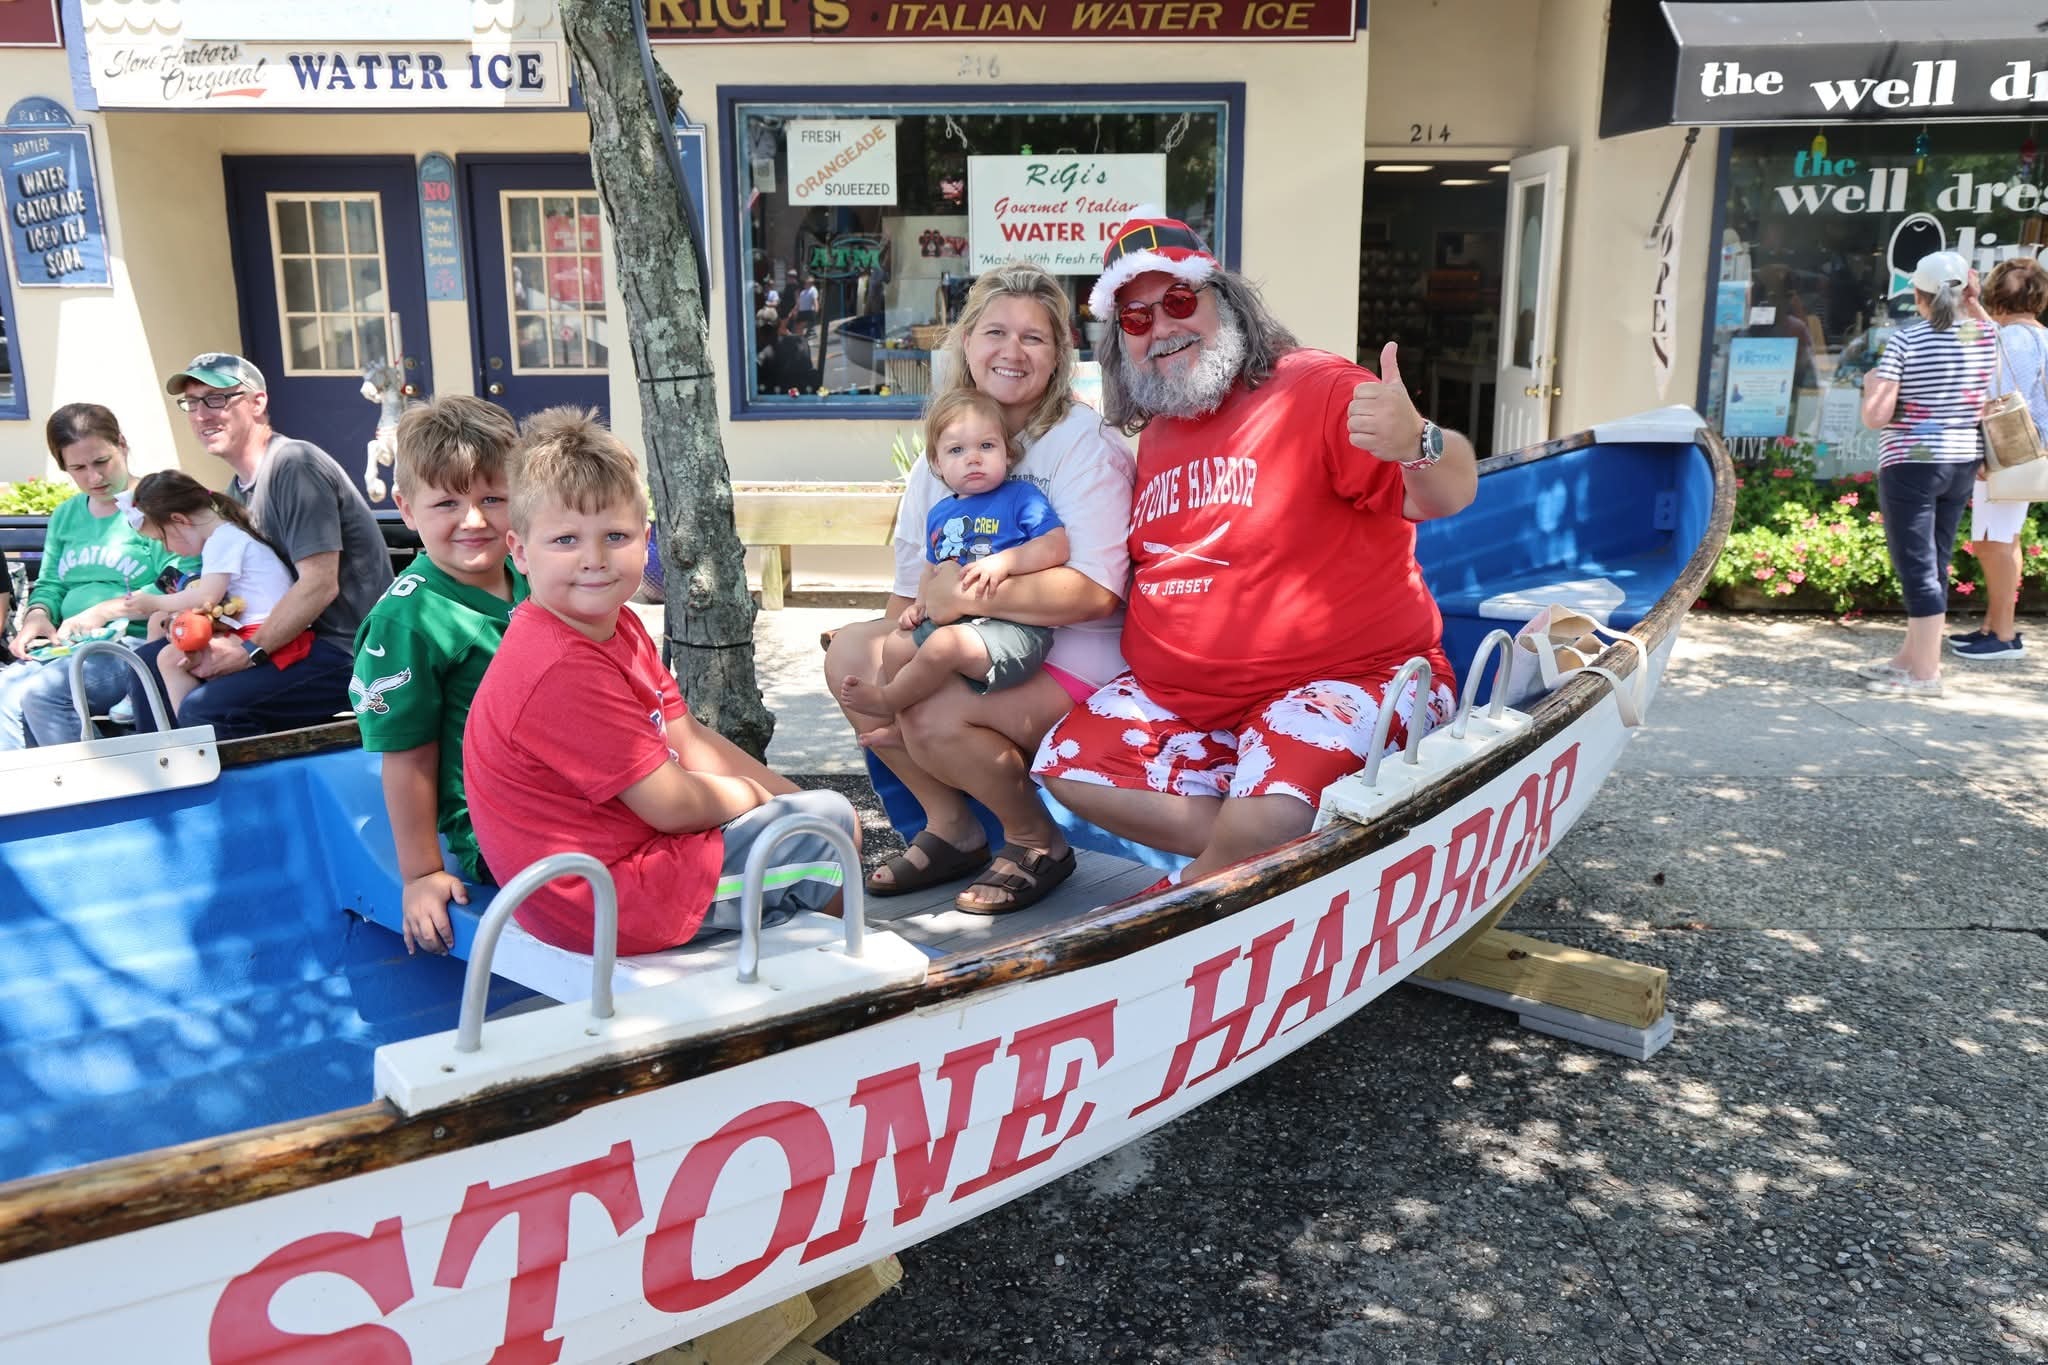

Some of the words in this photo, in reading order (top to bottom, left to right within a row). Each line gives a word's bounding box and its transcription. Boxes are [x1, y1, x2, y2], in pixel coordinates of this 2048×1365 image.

[648, 0, 850, 31] RIGIS
[886, 3, 1046, 31] ITALIAN
[1072, 3, 1223, 31] WATER
[1242, 2, 1315, 30] ICE
[104, 49, 155, 78] Stone
[160, 56, 267, 100] Original
[287, 53, 449, 91] WATER
[468, 53, 545, 90] ICE
[1699, 61, 1784, 98] the
[1809, 59, 1957, 112] well
[801, 130, 841, 143] FRESH
[1410, 123, 1451, 143] 214
[795, 125, 888, 198] ORANGEADE
[1793, 150, 1856, 178] the
[21, 166, 67, 196] WATER
[422, 181, 452, 202] NO
[825, 182, 890, 196] SQUEEZED
[1774, 167, 1908, 215] well
[16, 189, 87, 225] GATORADE
[994, 196, 1068, 220] Gourmet
[28, 224, 60, 251] ICED
[61, 216, 87, 243] TEA
[1001, 222, 1085, 242] WATER
[1099, 222, 1127, 242] IC
[45, 247, 83, 277] SODA
[811, 247, 881, 268] ATM
[1023, 253, 1051, 265] With
[1055, 253, 1085, 265] Fresh
[1652, 223, 1674, 369] OPEN
[1129, 465, 1183, 536] STONE
[1187, 456, 1258, 508] HARBOR
[974, 517, 999, 535] CREW
[58, 545, 149, 582] ACATION!
[1161, 577, 1214, 596] JERSEY
[208, 998, 1119, 1365] STONE
[1128, 741, 1582, 1119] HARBOR
